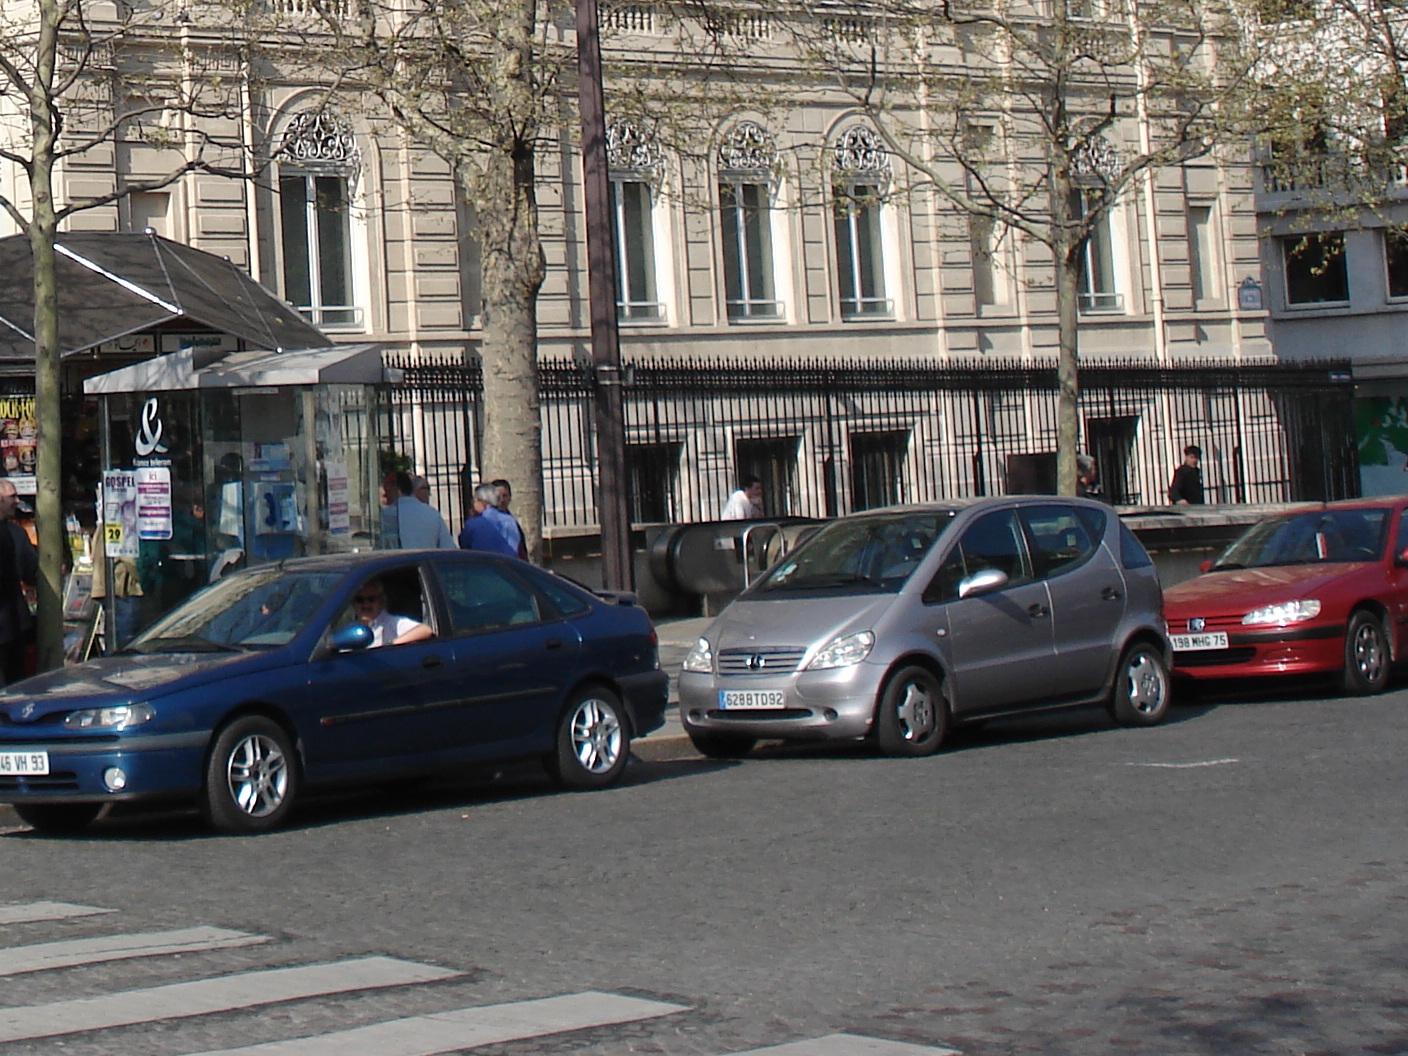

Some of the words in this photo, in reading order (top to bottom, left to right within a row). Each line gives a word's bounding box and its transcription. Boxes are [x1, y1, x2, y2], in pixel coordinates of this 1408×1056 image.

[105, 476, 135, 487] GOSPEL
[108, 528, 121, 540] 29
[1213, 634, 1226, 646] 75
[14, 755, 28, 771] VH
[30, 755, 45, 771] 93
